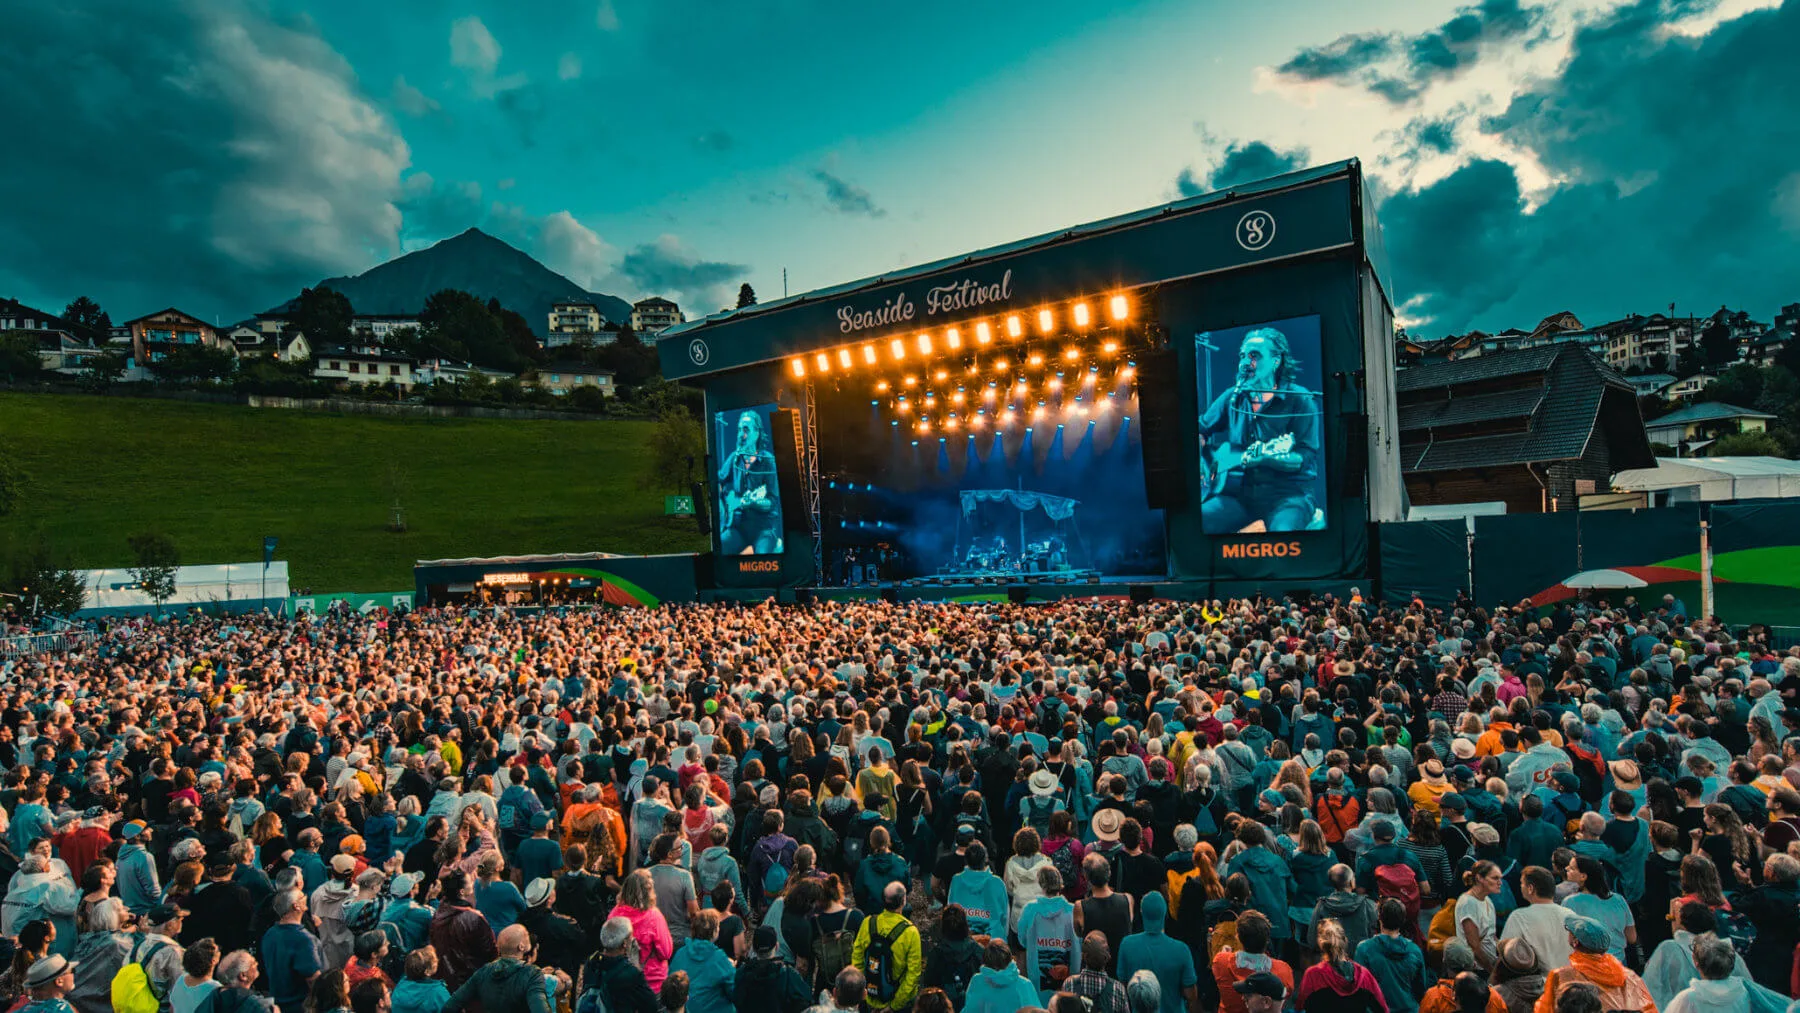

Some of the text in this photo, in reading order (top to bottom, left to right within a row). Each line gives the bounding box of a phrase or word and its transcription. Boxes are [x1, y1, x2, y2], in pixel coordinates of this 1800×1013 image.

[837, 268, 1013, 334] Seaside Festival
[1222, 541, 1302, 559] MIGROS
[739, 560, 780, 572] MIGROS
